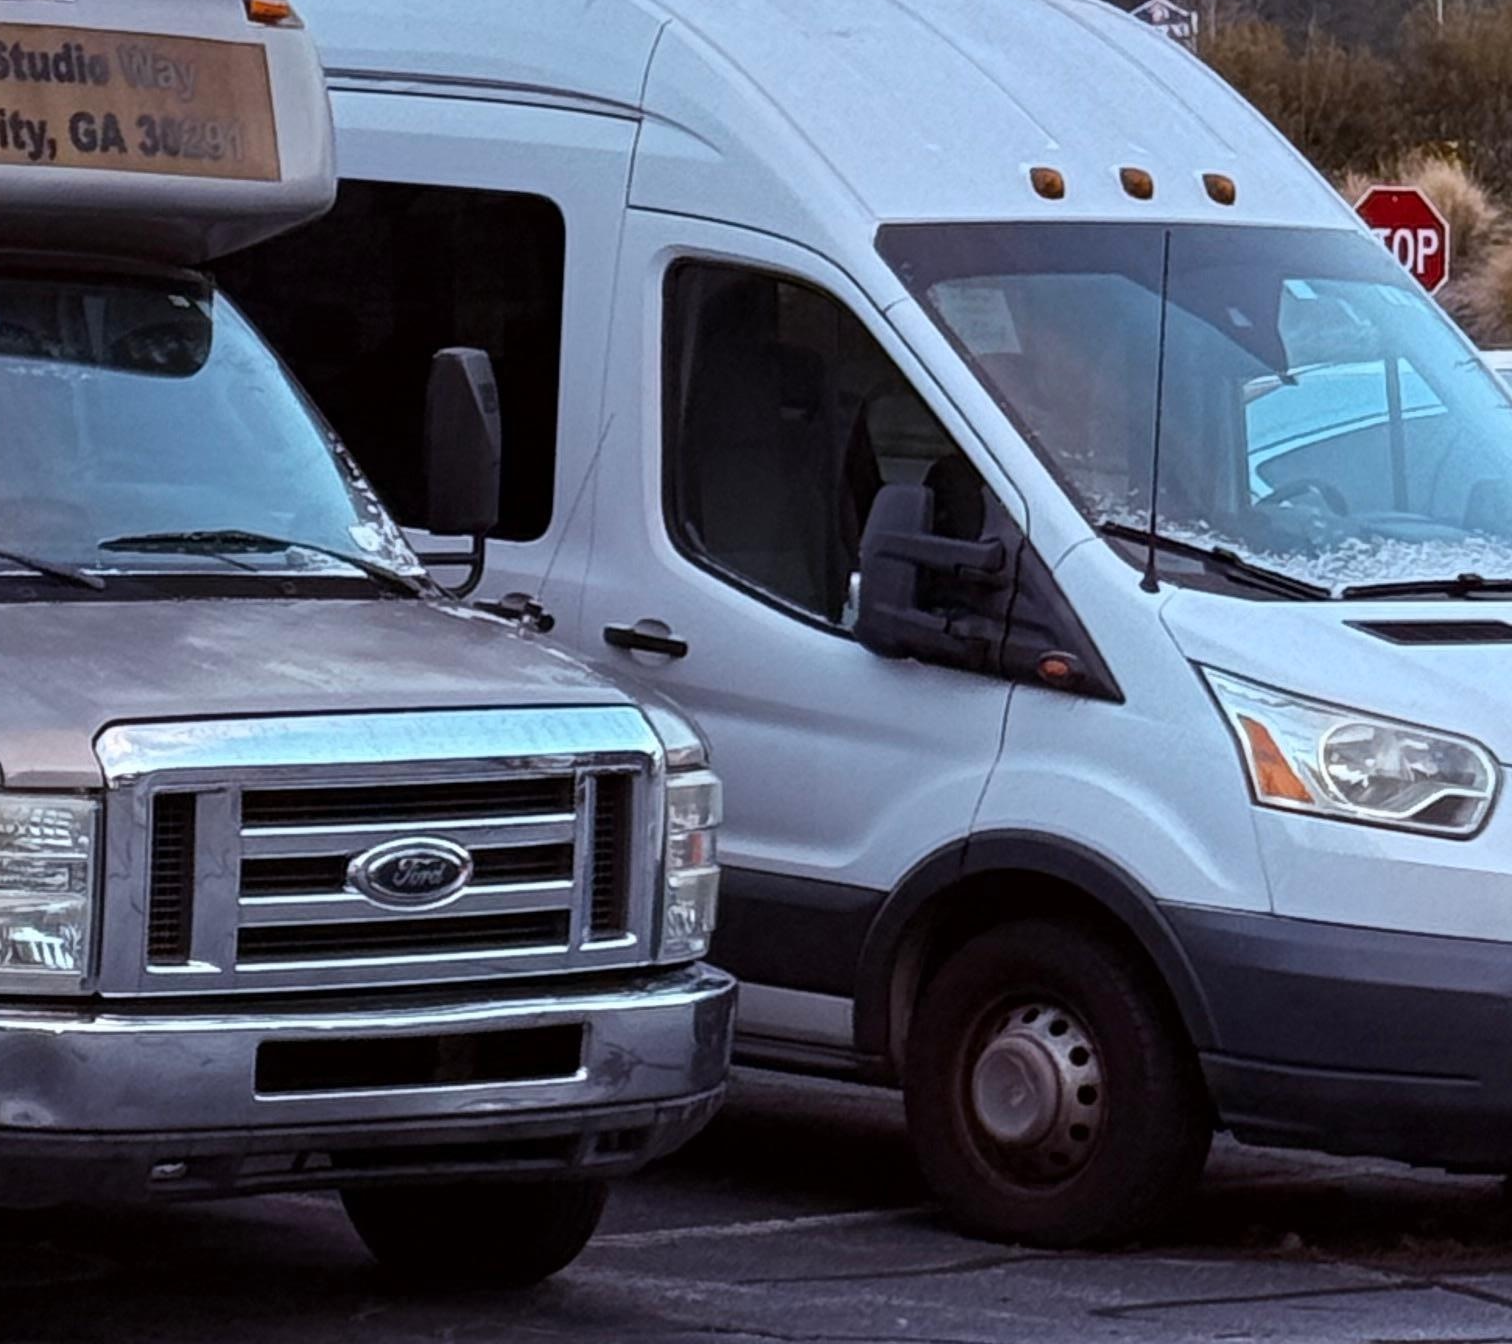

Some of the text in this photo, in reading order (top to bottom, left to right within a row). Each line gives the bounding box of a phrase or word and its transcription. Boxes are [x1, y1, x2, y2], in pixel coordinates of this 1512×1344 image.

[117, 45, 197, 103] Way
[68, 112, 128, 155] GA
[135, 114, 245, 162] 30291
[1370, 227, 1439, 274] TOP
[392, 858, 446, 887] Ford
